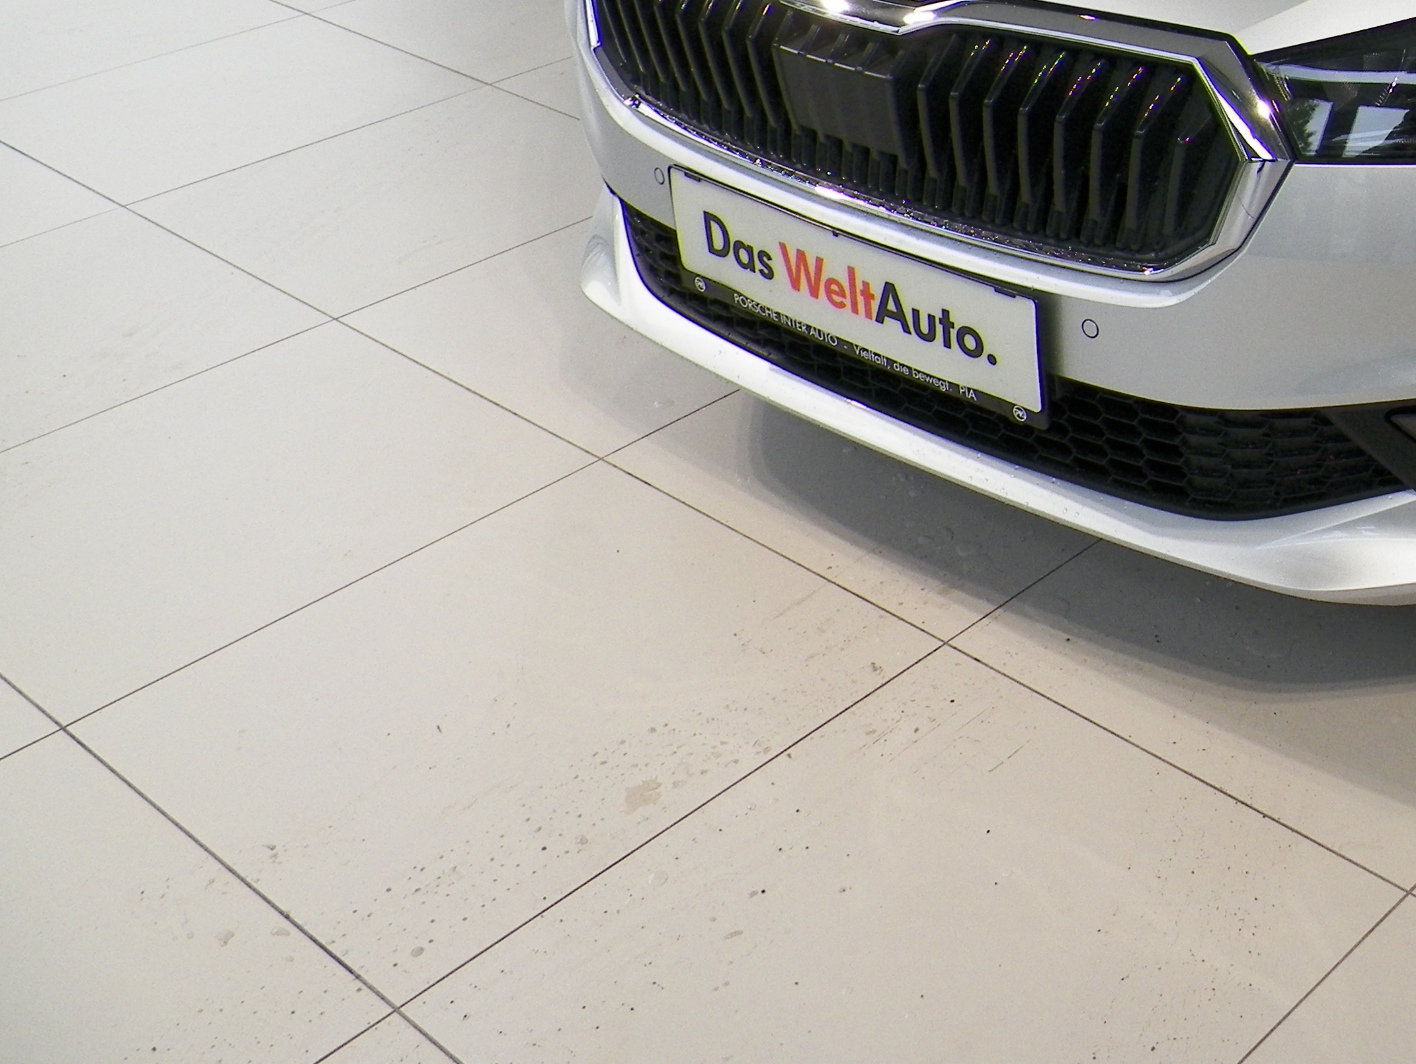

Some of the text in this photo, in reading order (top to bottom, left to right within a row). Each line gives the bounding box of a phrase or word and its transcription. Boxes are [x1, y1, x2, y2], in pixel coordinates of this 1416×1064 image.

[703, 211, 774, 280] Das
[733, 293, 779, 322] PORSCHE
[780, 314, 808, 334] INTER
[809, 327, 839, 347] AUTO
[893, 361, 909, 376] die
[959, 385, 977, 401] PIA
